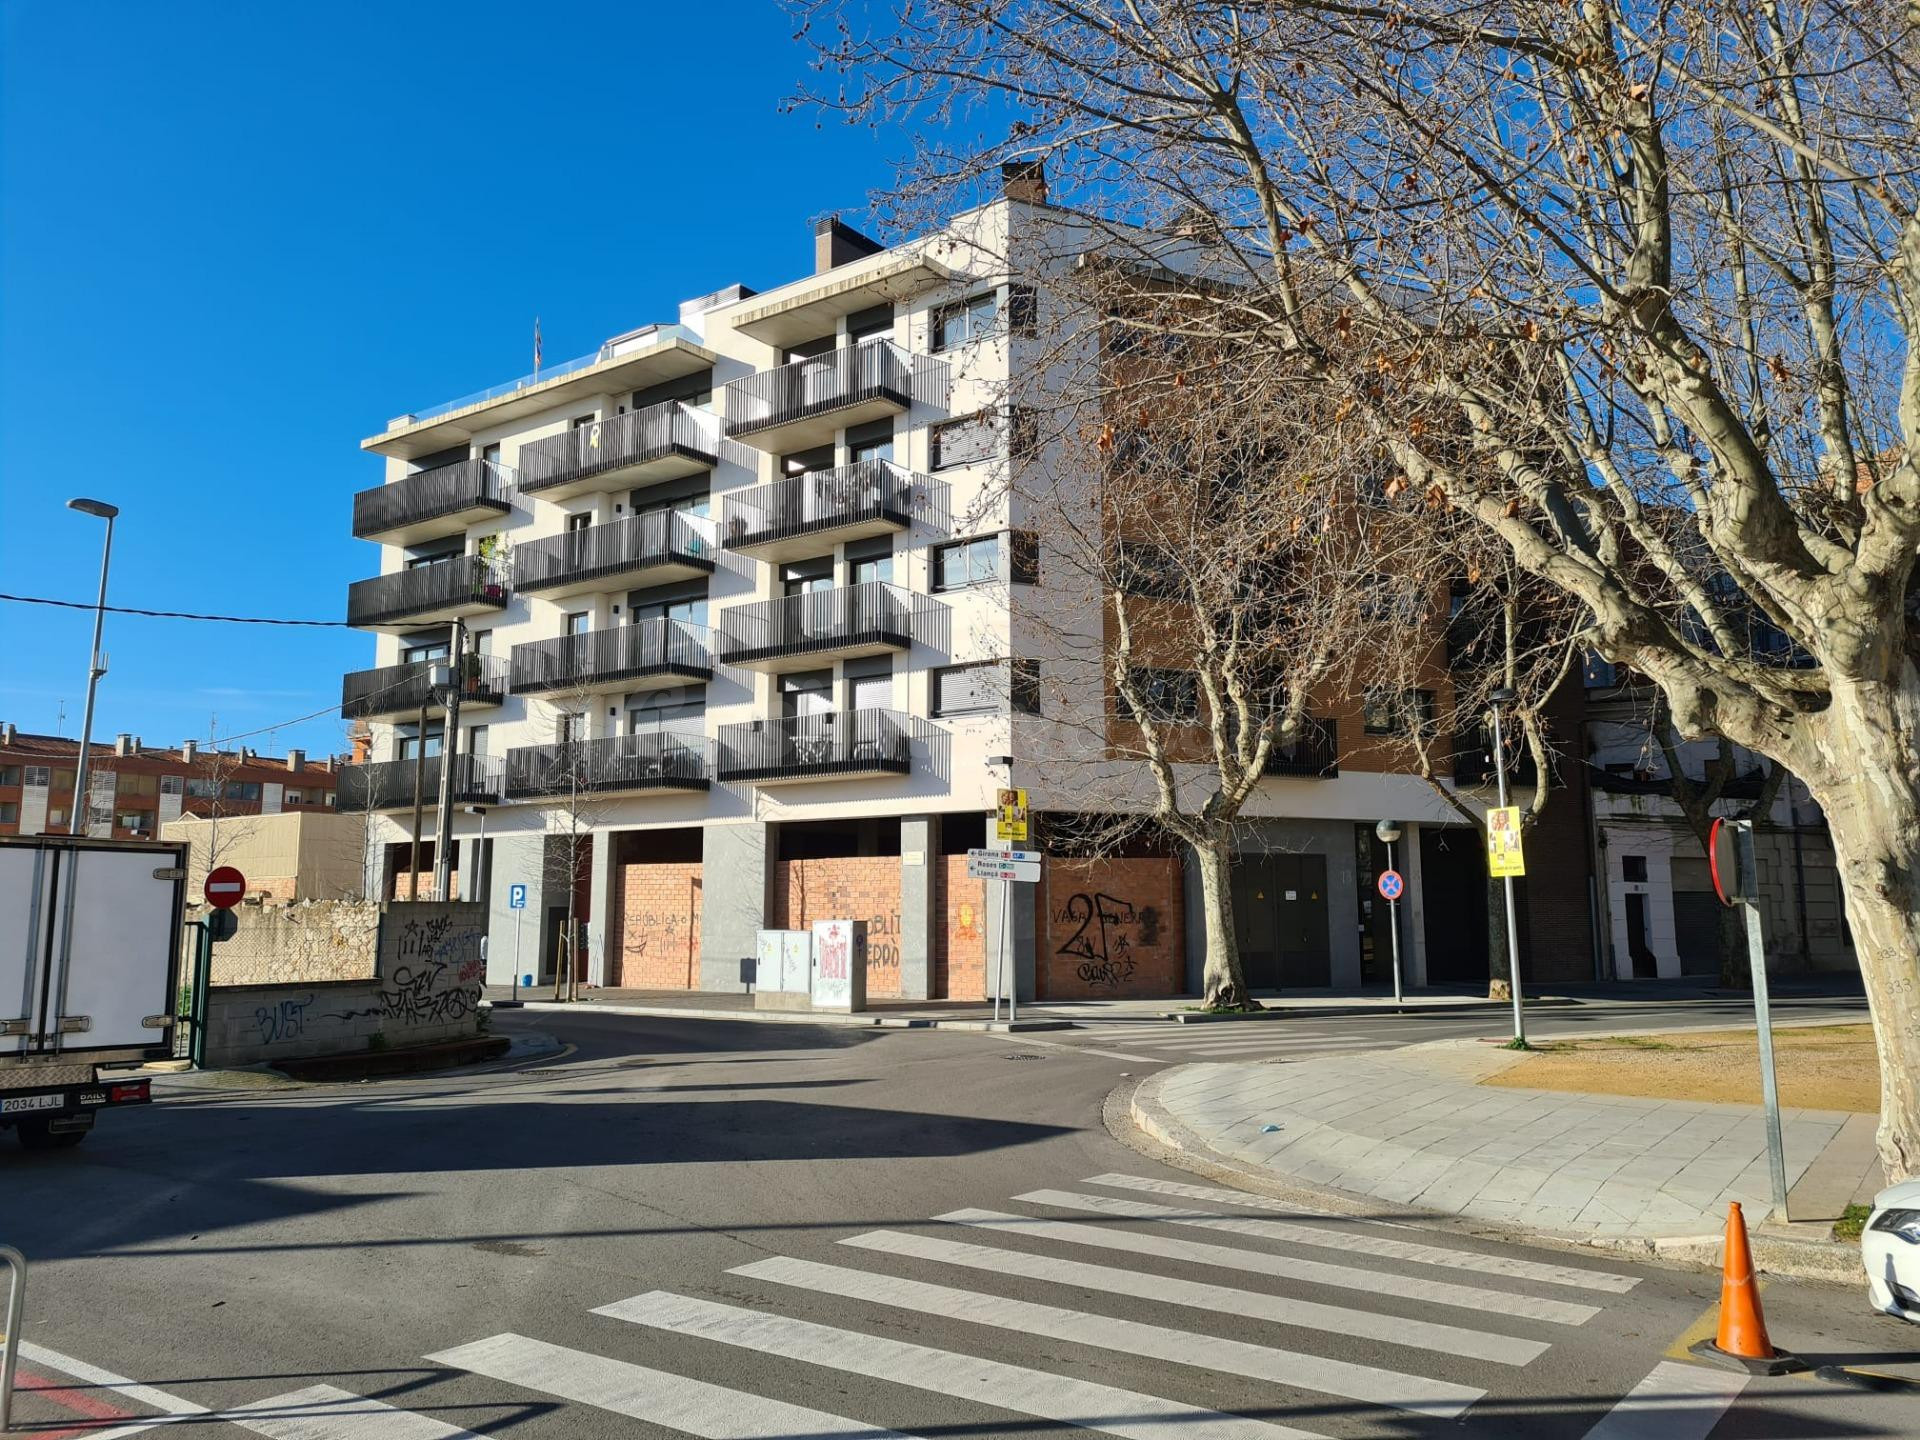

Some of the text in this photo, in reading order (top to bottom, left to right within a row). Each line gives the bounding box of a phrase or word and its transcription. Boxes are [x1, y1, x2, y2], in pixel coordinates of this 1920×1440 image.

[977, 850, 998, 858] Girona
[4, 1096, 61, 1111] 2034 LJL
